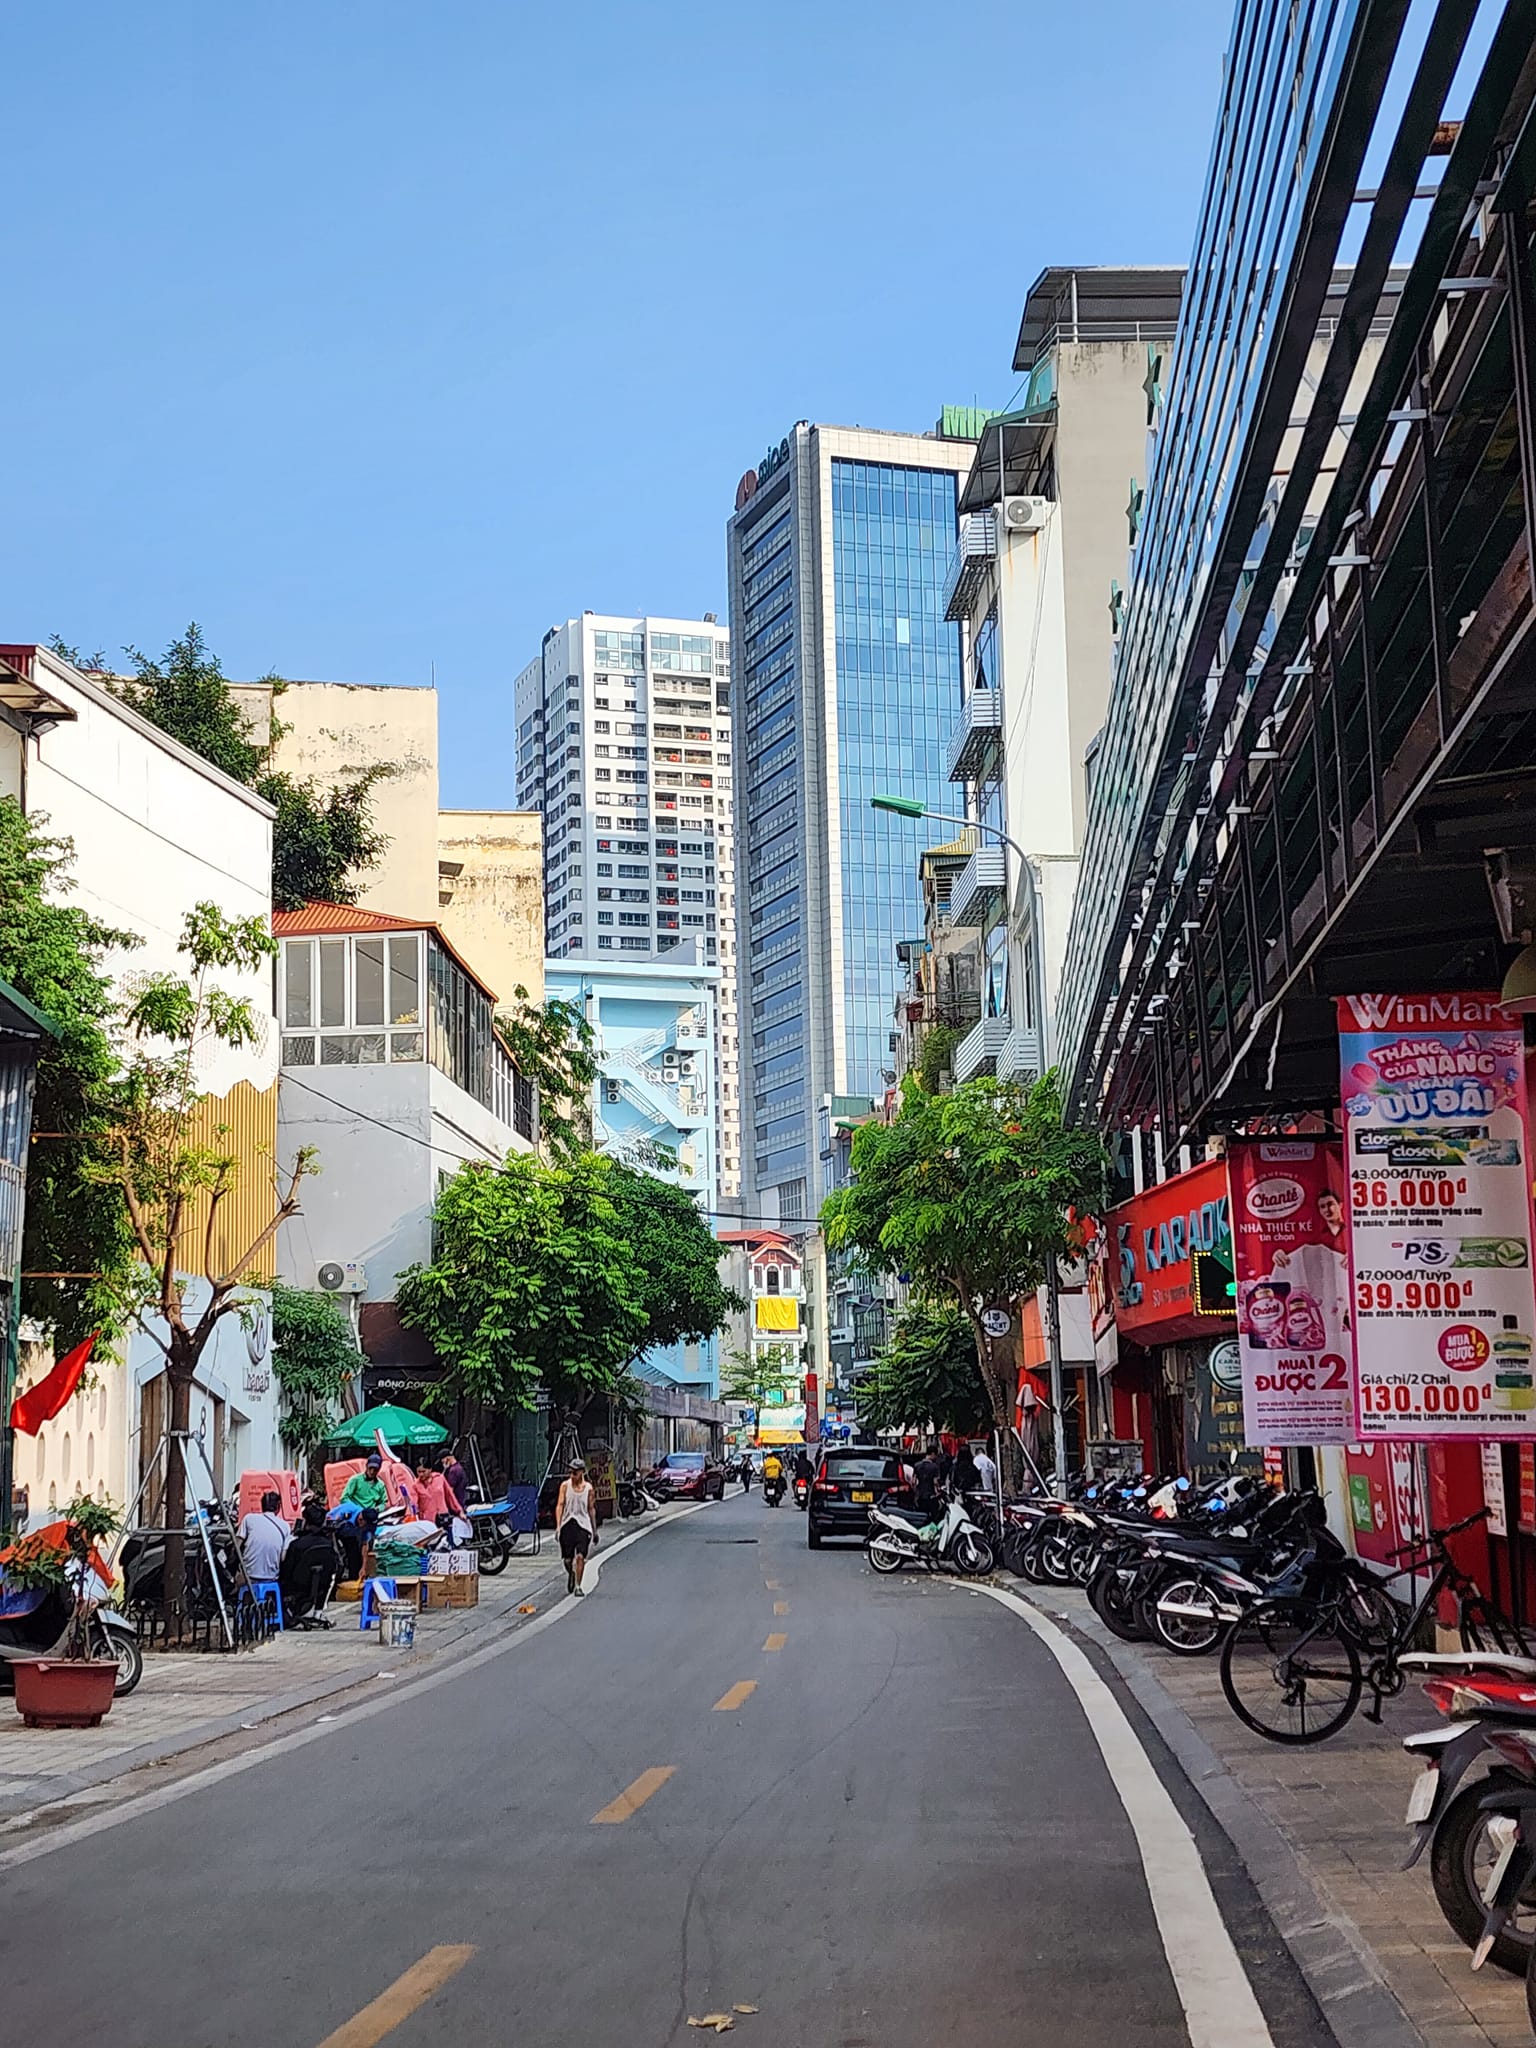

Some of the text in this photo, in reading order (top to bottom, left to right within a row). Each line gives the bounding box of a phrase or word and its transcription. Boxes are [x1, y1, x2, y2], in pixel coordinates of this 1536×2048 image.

[1432, 1080, 1497, 1113] ĐÃI
[1391, 1145, 1448, 1160] closeup
[1252, 1187, 1299, 1208] Chanté
[1353, 1178, 1467, 1207] 36.000đ
[1404, 1242, 1443, 1261] P/S
[1358, 1280, 1473, 1309] 39.900đ
[1447, 1334, 1470, 1347] MUA
[1476, 1341, 1486, 1358] 2
[1278, 1355, 1316, 1371] MUA 1
[1255, 1353, 1349, 1395] ĐƯỢC 2
[1421, 1373, 1451, 1385] Chai
[1361, 1383, 1491, 1412] 130.000đ
